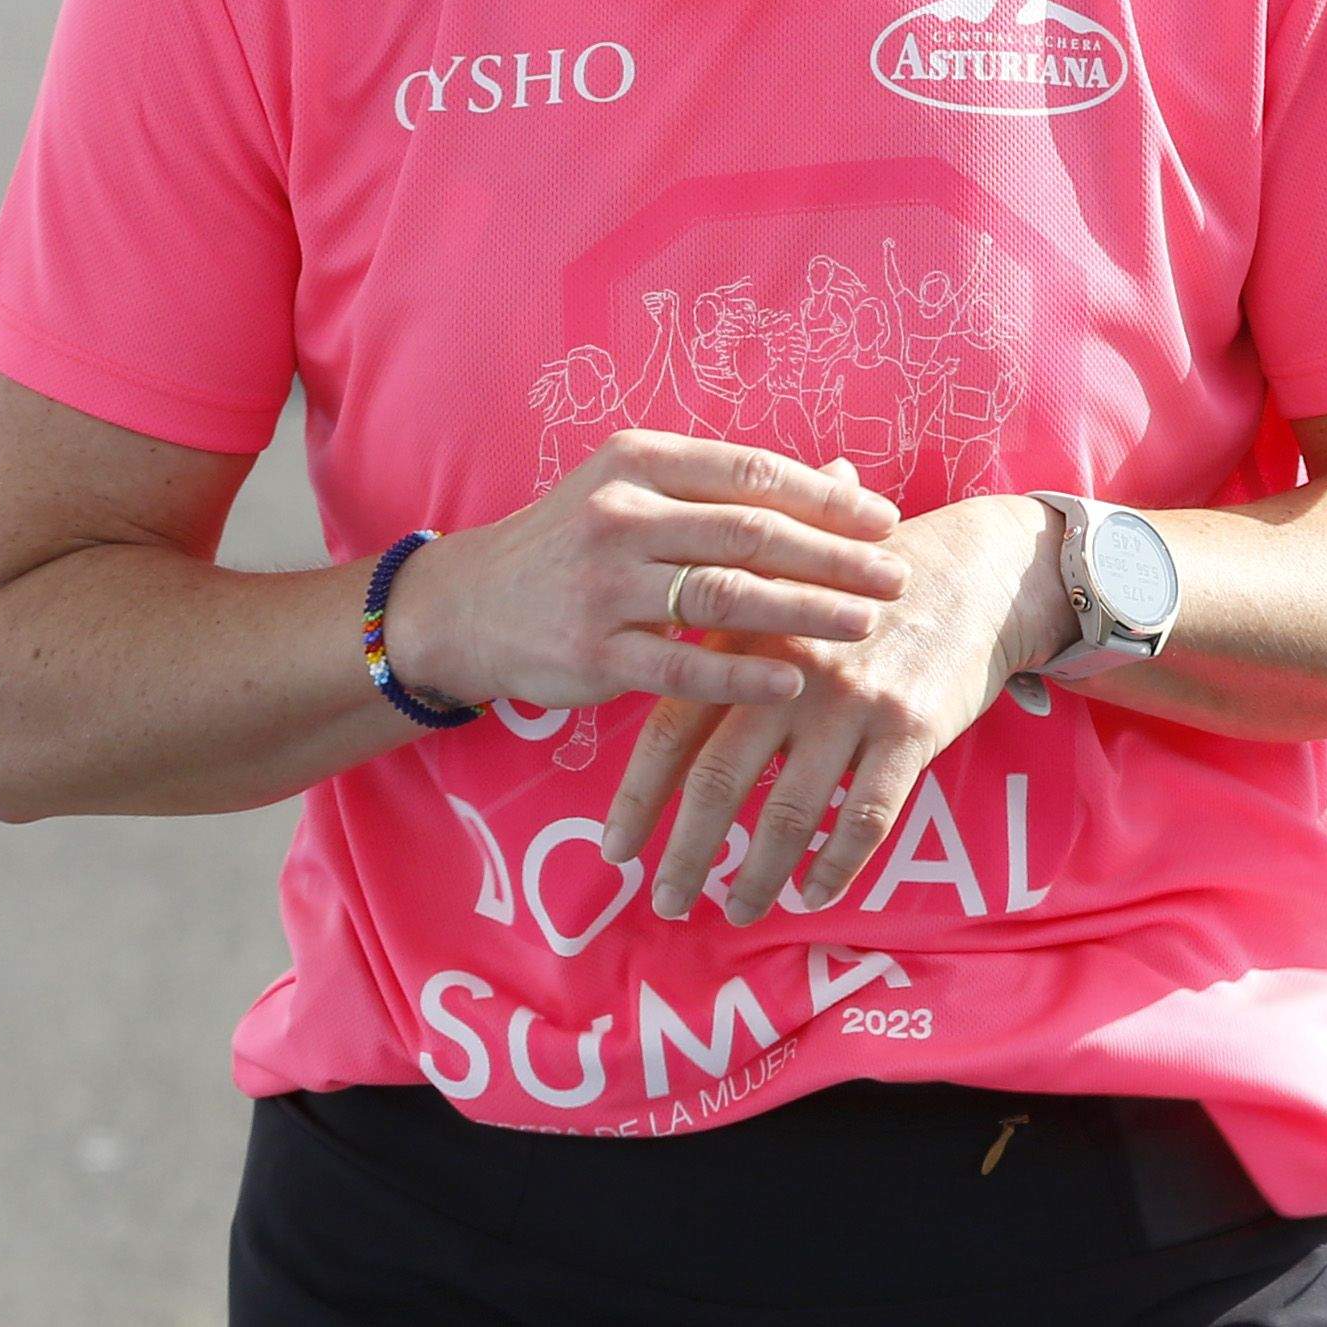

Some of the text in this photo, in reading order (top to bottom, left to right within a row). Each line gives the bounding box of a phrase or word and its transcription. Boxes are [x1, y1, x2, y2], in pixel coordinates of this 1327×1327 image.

[890, 32, 1110, 89] ASTURIANA
[1023, 33, 1102, 51] LECHERA
[418, 943, 913, 1109] SUMA
[841, 1006, 933, 1040] 2023
[648, 1099, 694, 1138] LA
[698, 1037, 799, 1118] MUJER
